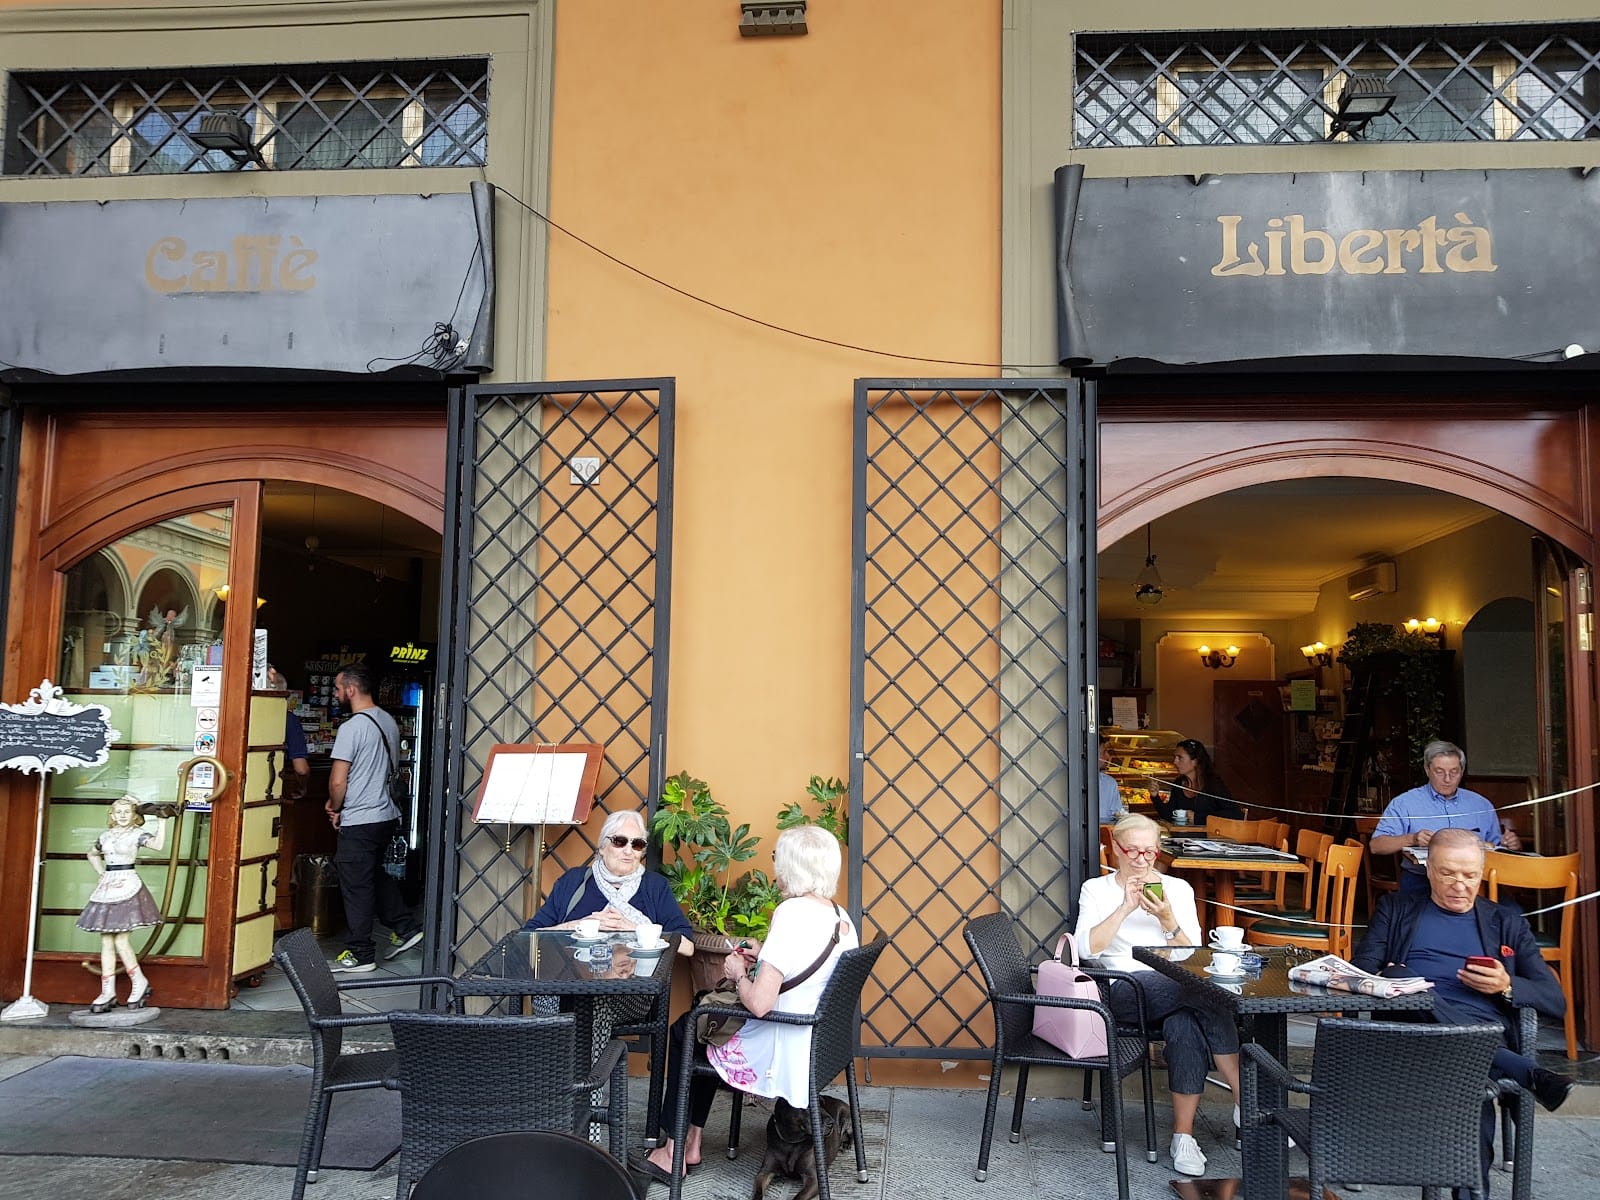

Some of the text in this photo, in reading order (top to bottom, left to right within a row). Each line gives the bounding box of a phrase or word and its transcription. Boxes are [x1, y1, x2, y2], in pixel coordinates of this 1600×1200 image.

[145, 235, 318, 293] Caffè
[1211, 212, 1498, 276] Libertà
[390, 647, 429, 660] PRINZ
